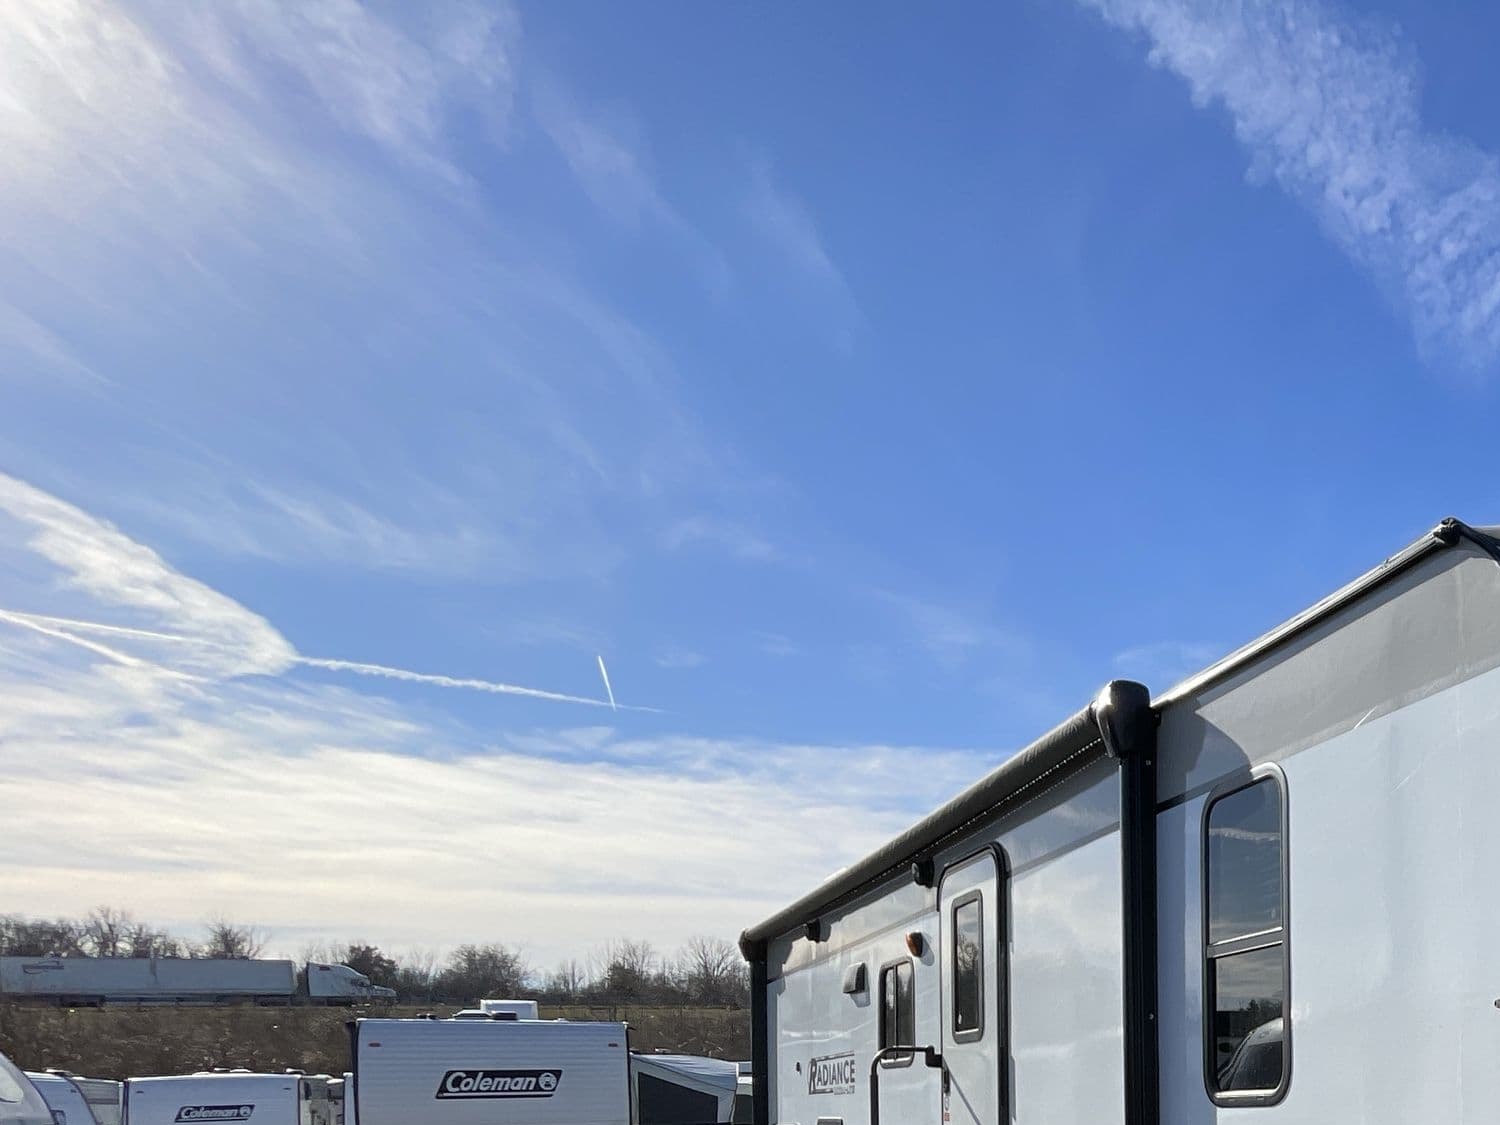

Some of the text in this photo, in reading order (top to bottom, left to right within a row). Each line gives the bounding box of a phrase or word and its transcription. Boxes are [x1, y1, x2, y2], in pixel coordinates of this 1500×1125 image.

[446, 1071, 537, 1093] Coleman
[808, 1056, 856, 1096] RADIANCE
[181, 1107, 239, 1119] Coleman
